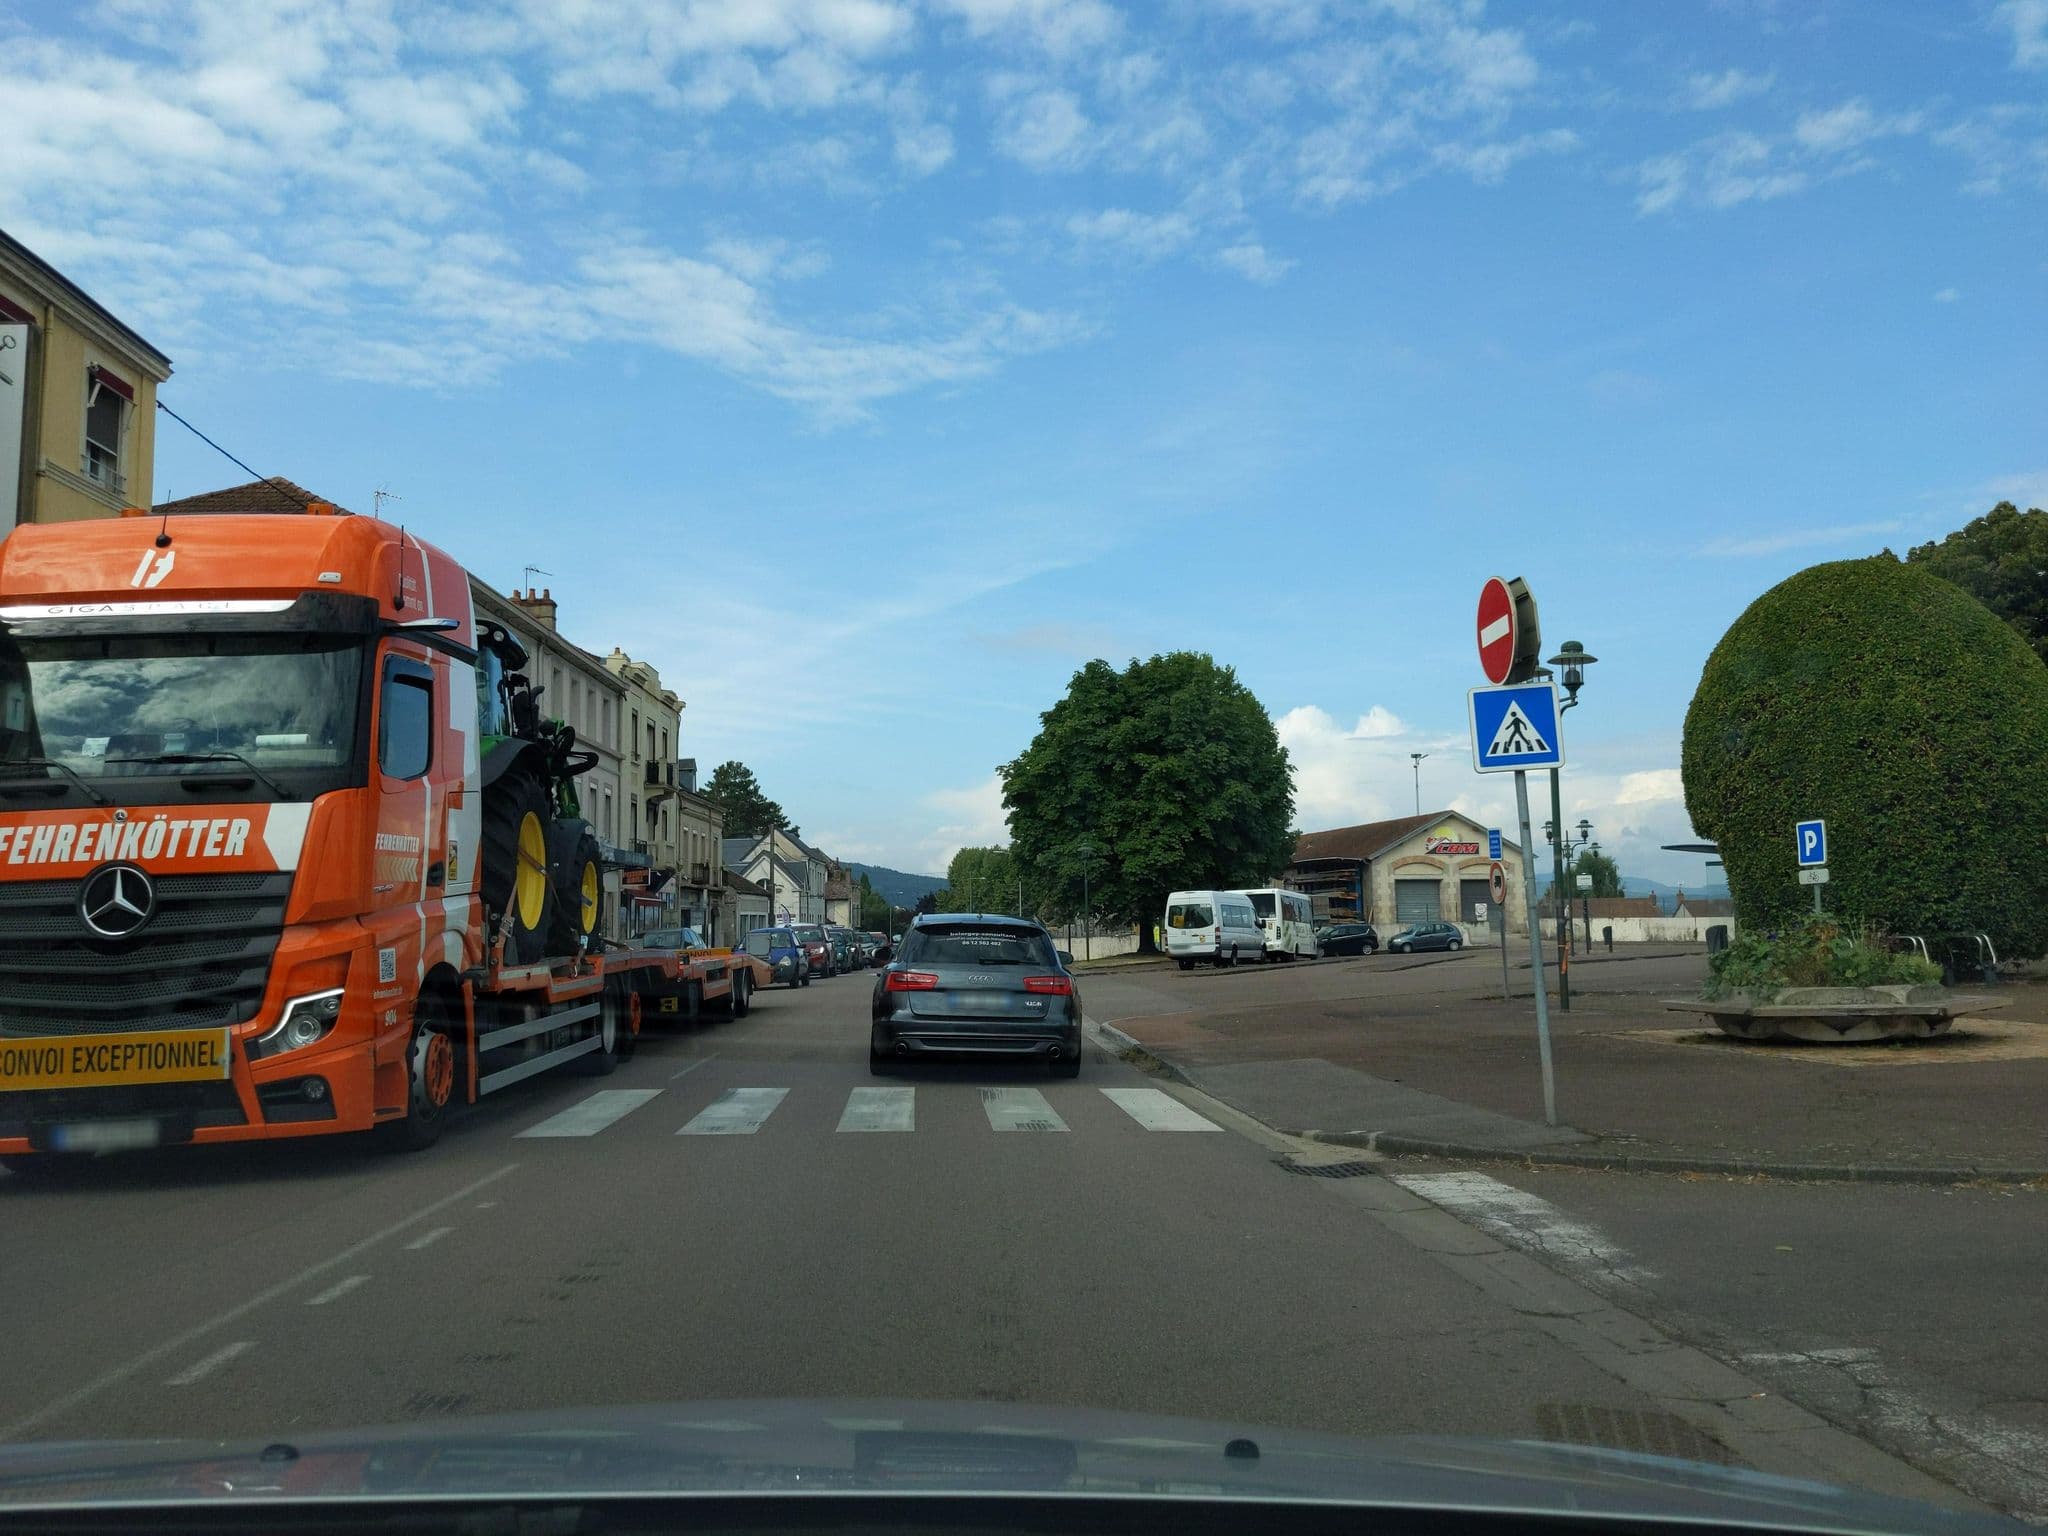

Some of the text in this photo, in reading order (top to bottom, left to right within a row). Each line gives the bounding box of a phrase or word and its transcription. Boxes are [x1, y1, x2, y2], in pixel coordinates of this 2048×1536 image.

[0, 814, 250, 865] FEHRENKÖTTER
[1804, 830, 1818, 856] P
[0, 1040, 219, 1076] ONVOI EXCEPTIONNEL
